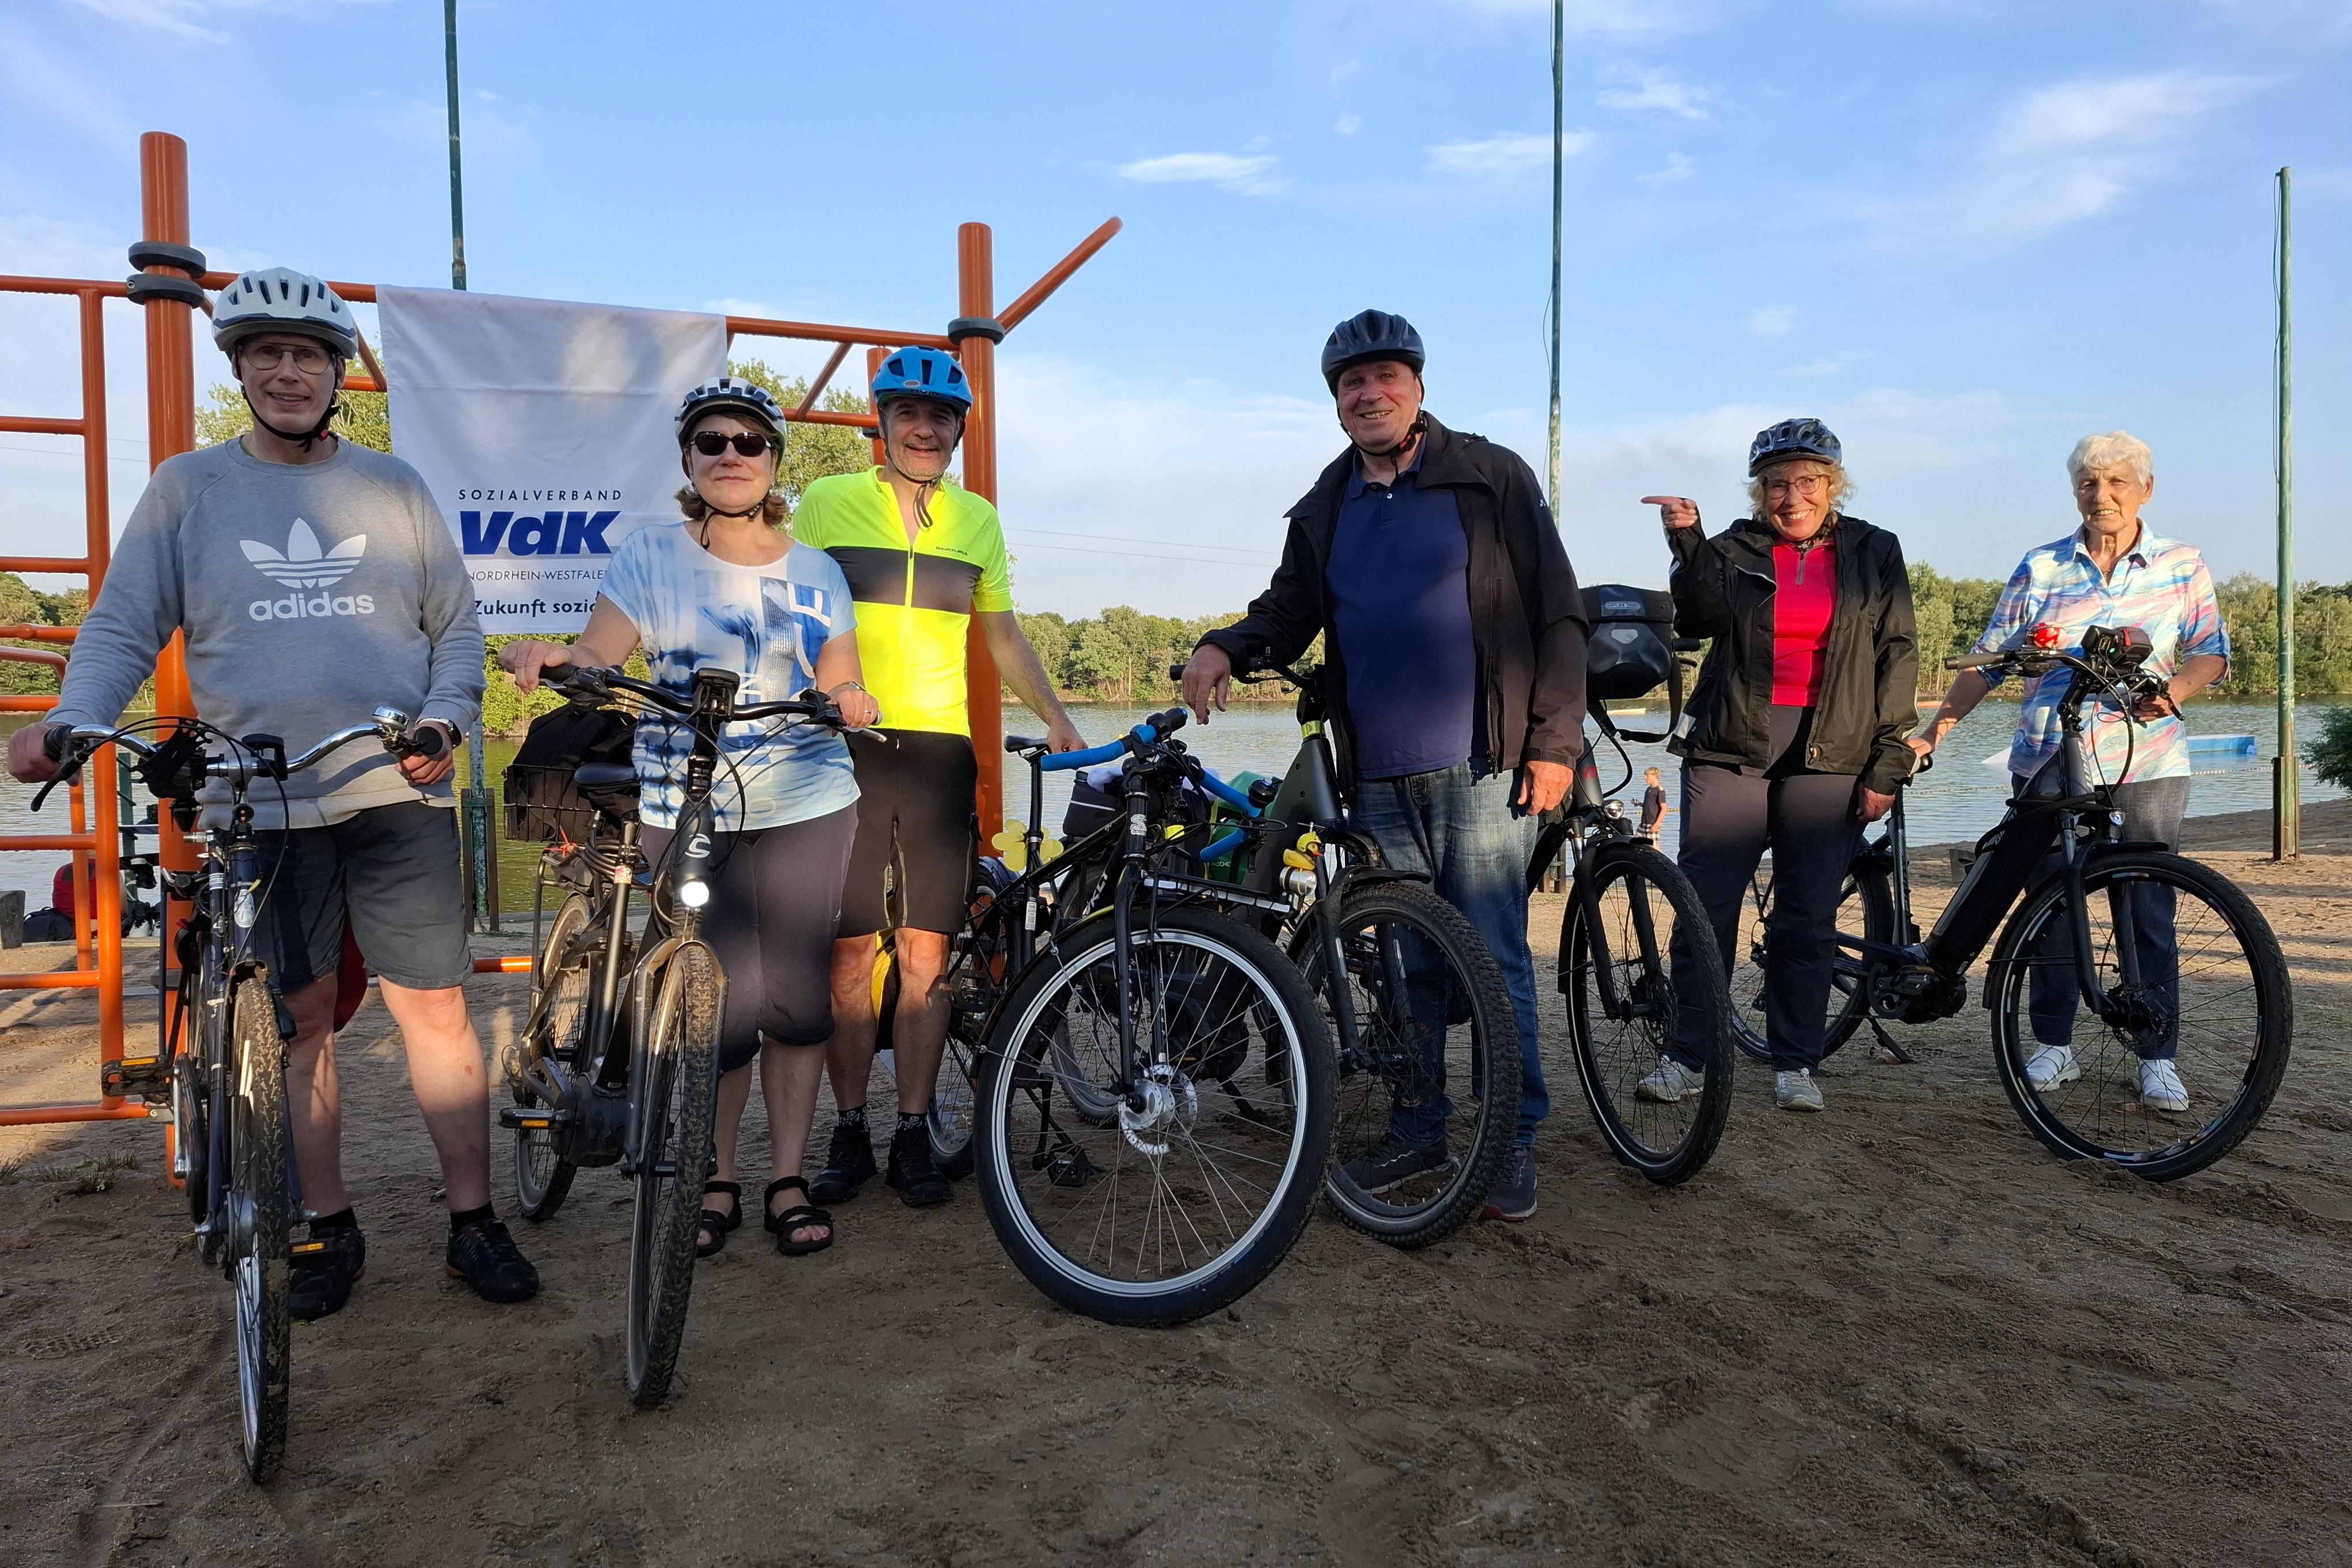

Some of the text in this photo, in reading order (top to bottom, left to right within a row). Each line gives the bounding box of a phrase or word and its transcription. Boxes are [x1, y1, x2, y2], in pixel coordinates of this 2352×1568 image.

[458, 489, 621, 500] SOZIALVERBAND
[459, 511, 621, 556] VdK
[936, 546, 968, 556] ENDURA
[469, 570, 606, 581] NORDRHEIN-WESTFALE
[248, 591, 375, 621] adidas
[474, 600, 546, 617] Zukunft
